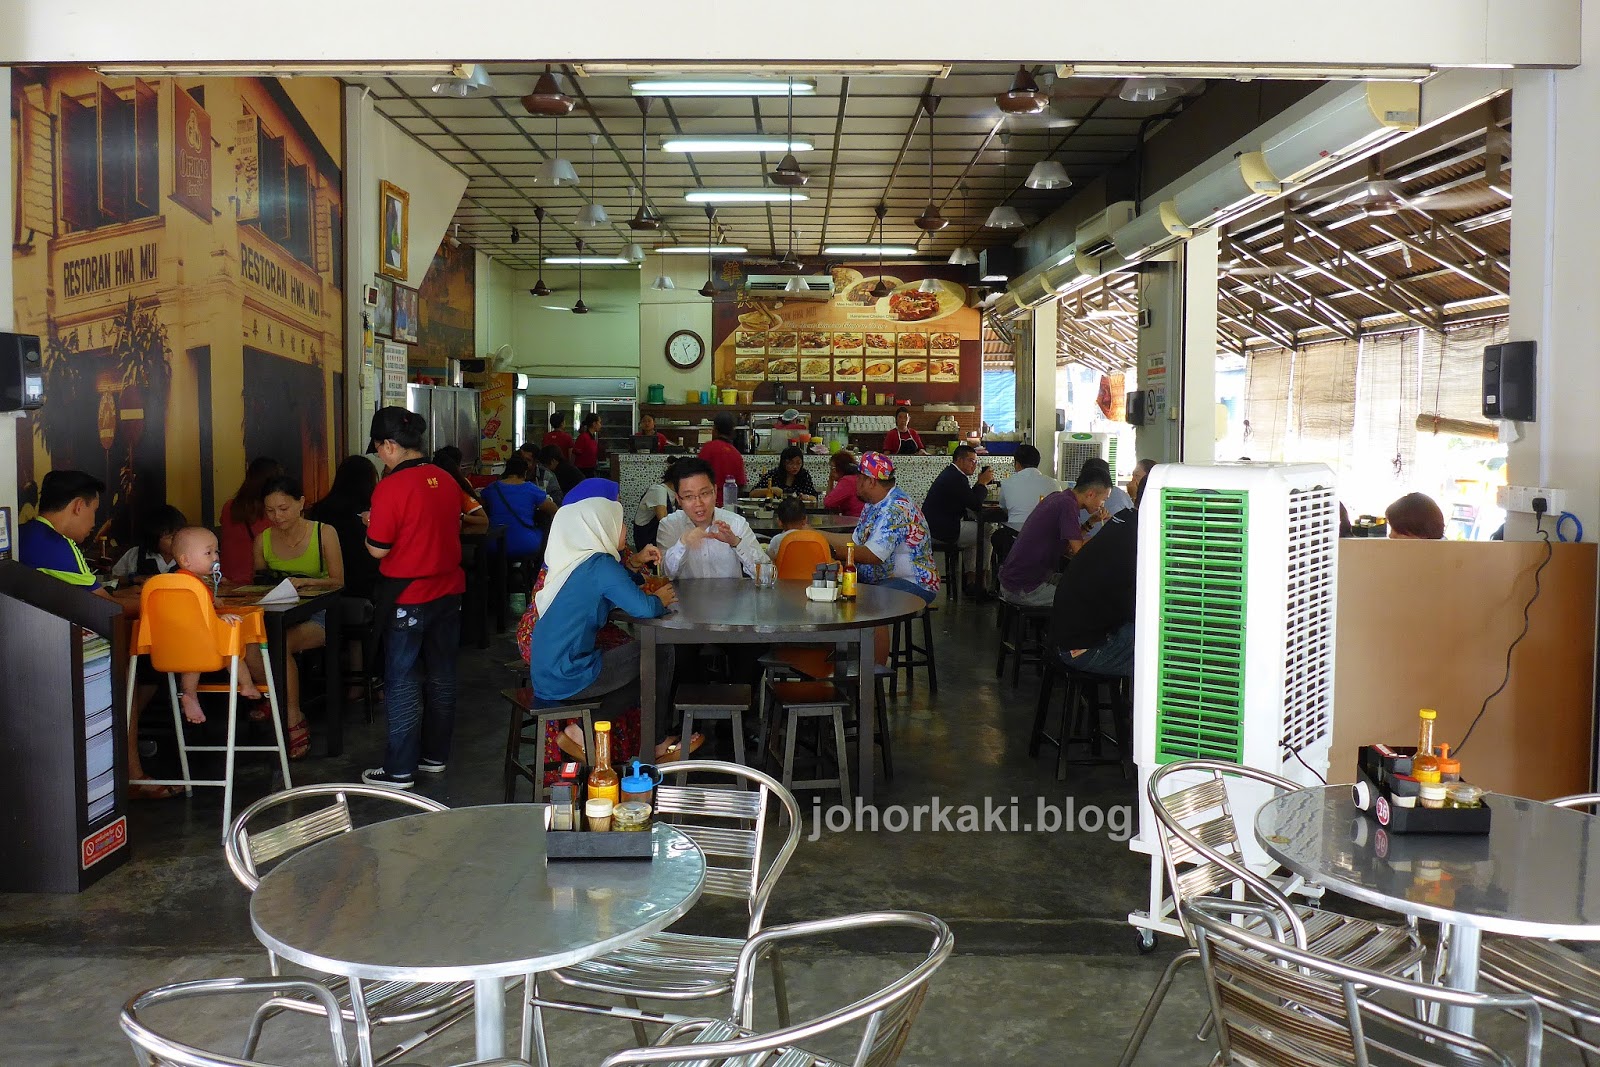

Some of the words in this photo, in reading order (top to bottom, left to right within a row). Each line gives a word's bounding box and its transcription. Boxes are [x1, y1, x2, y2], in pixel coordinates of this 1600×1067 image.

[64, 253, 111, 297] RESTORAN
[115, 248, 135, 286] HWA
[140, 243, 157, 280] MUI
[240, 242, 287, 299] RESTORAN
[290, 275, 306, 309] HWA
[308, 287, 320, 317] MUI
